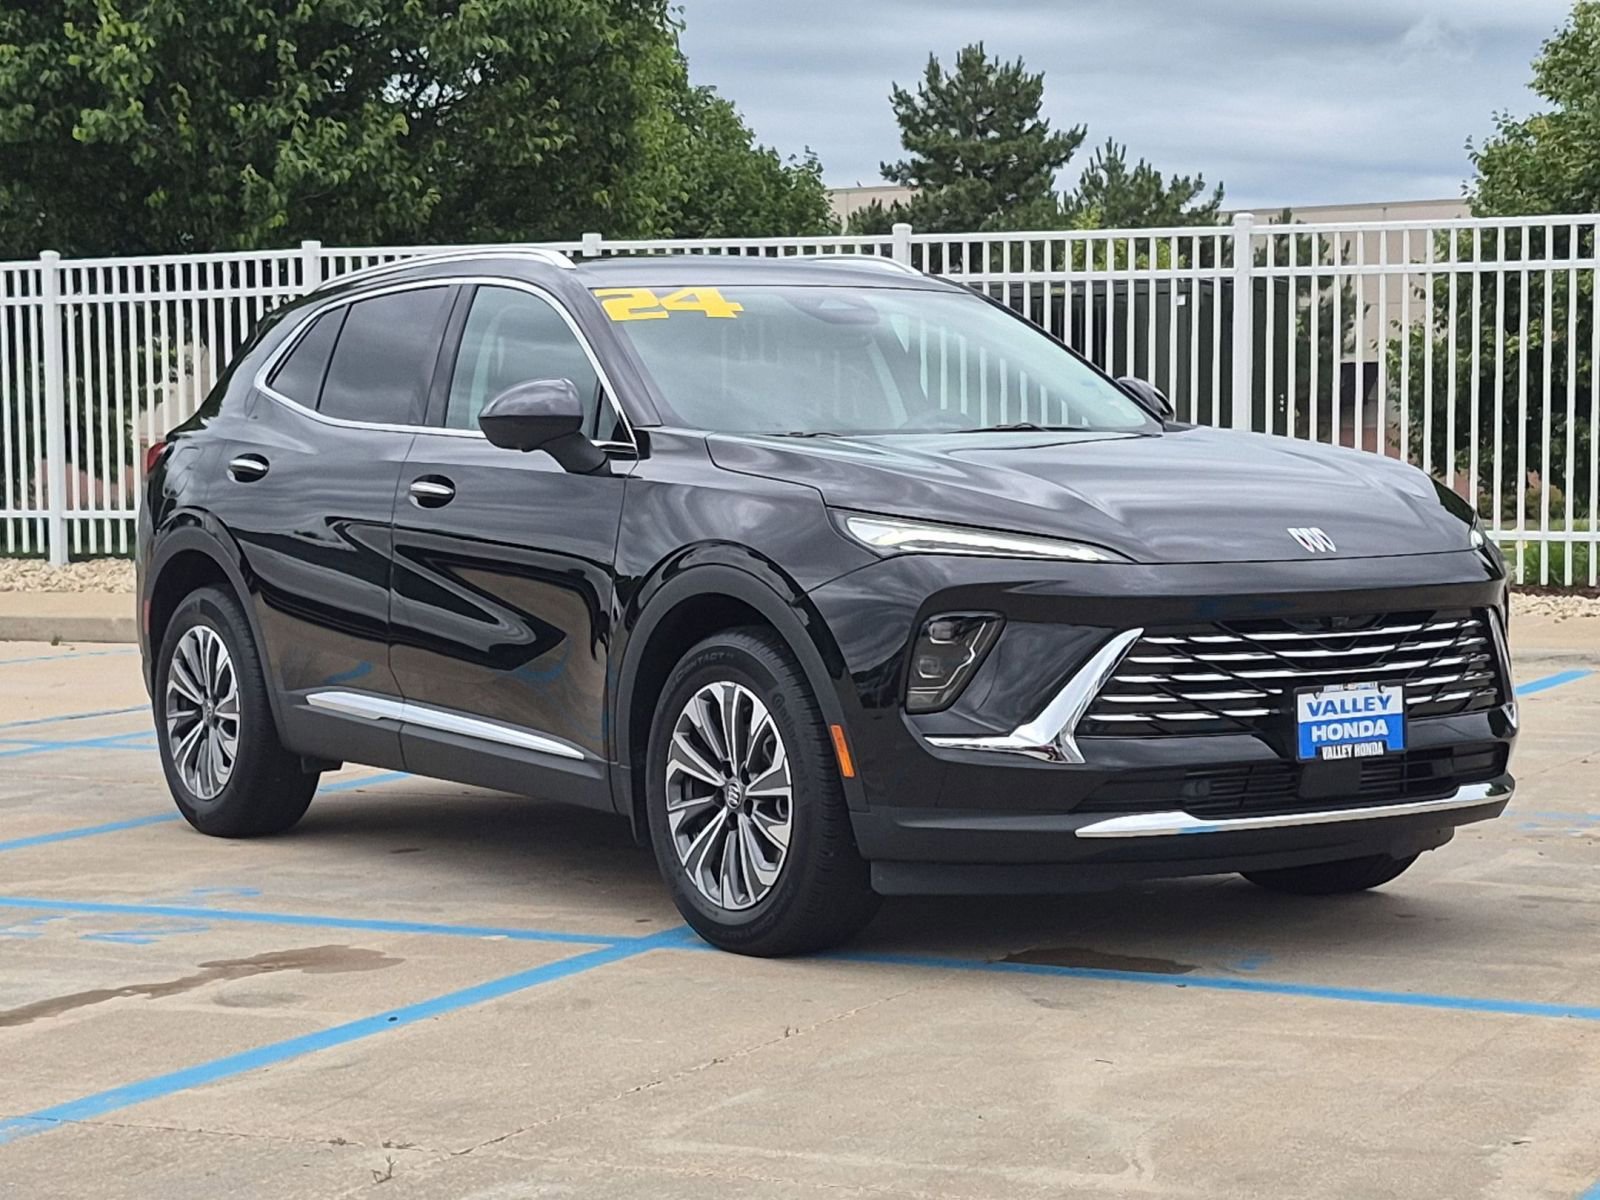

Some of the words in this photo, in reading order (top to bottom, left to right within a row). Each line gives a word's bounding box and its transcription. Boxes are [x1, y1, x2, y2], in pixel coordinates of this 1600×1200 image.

[593, 287, 745, 321] 24
[1306, 694, 1392, 717] VALLEY
[1311, 719, 1389, 743] HONDA
[1322, 743, 1353, 760] VALLEY
